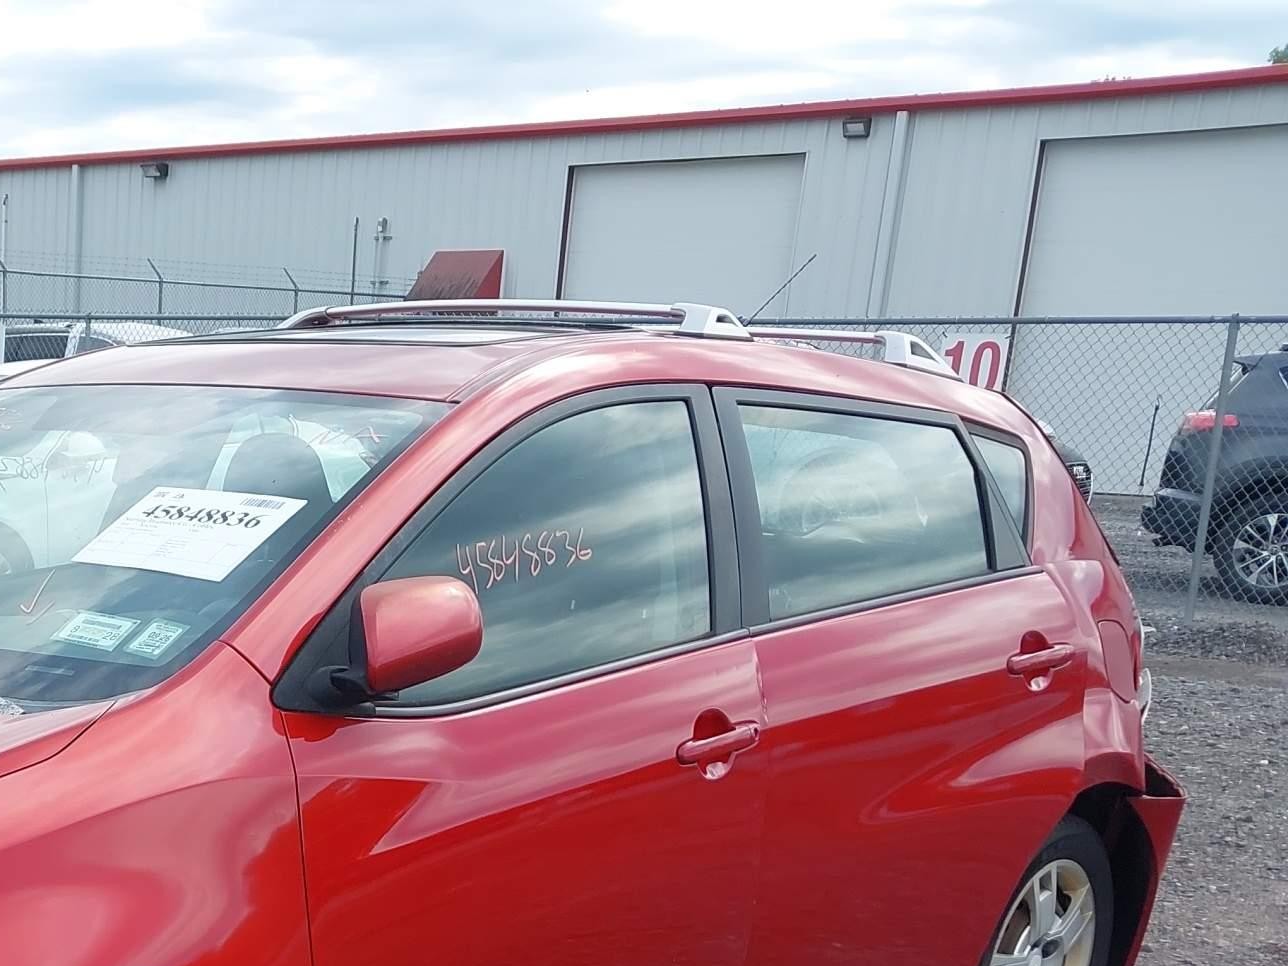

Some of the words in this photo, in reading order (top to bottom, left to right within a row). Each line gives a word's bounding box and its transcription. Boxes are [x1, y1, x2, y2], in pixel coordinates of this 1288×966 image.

[944, 340, 1001, 390] 10
[142, 504, 271, 529] 45848836
[456, 527, 593, 595] 45848836
